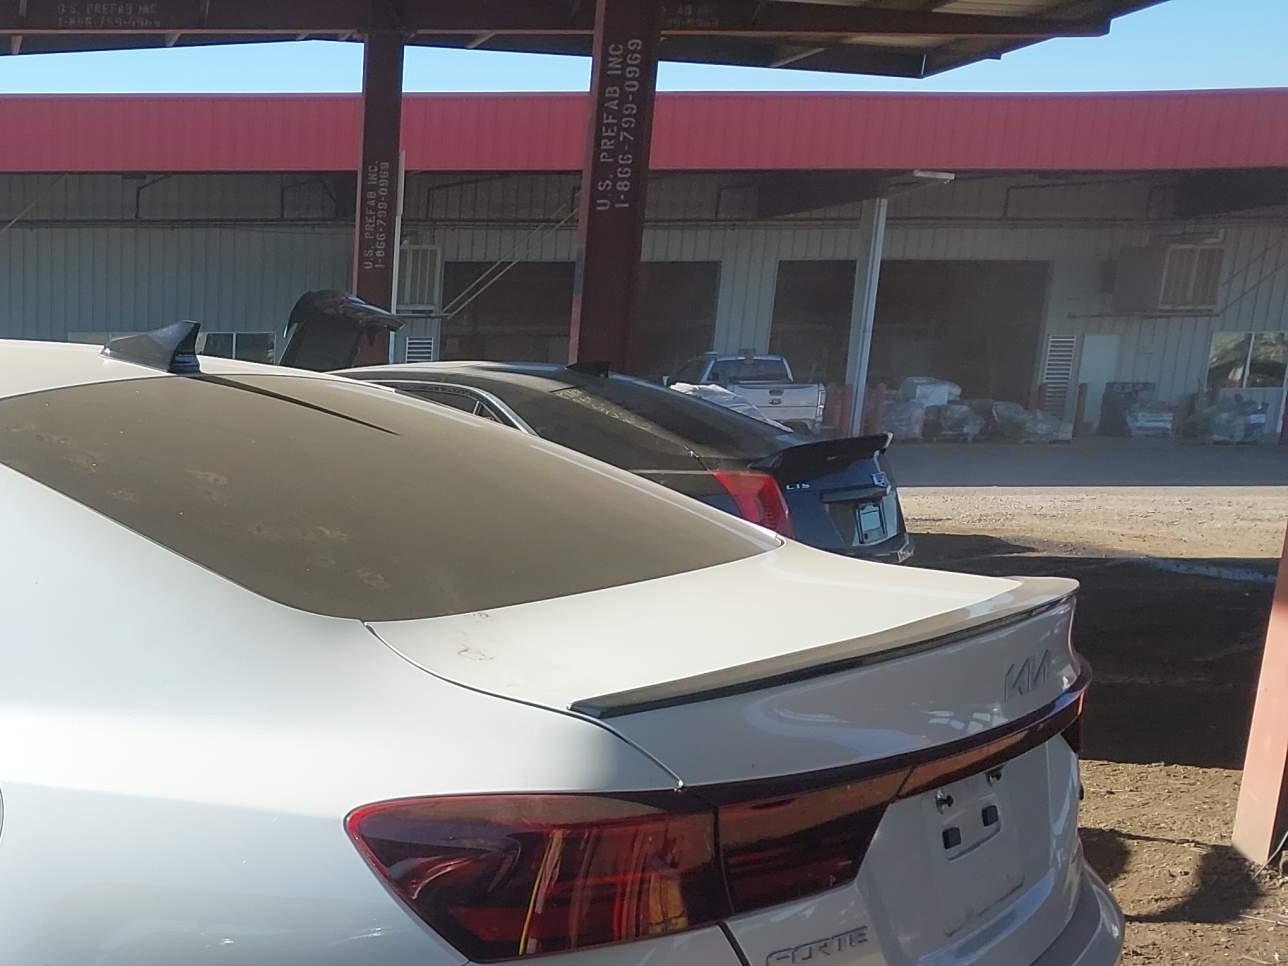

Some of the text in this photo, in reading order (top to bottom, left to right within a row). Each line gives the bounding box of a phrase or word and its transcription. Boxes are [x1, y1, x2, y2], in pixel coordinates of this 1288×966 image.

[596, 44, 624, 210] U.S. PREFAB INC
[615, 39, 643, 208] 1-866-799-0969
[363, 246, 374, 270] U.S.
[365, 191, 376, 239] PREFAB
[374, 161, 390, 268] 1-866-799-0969
